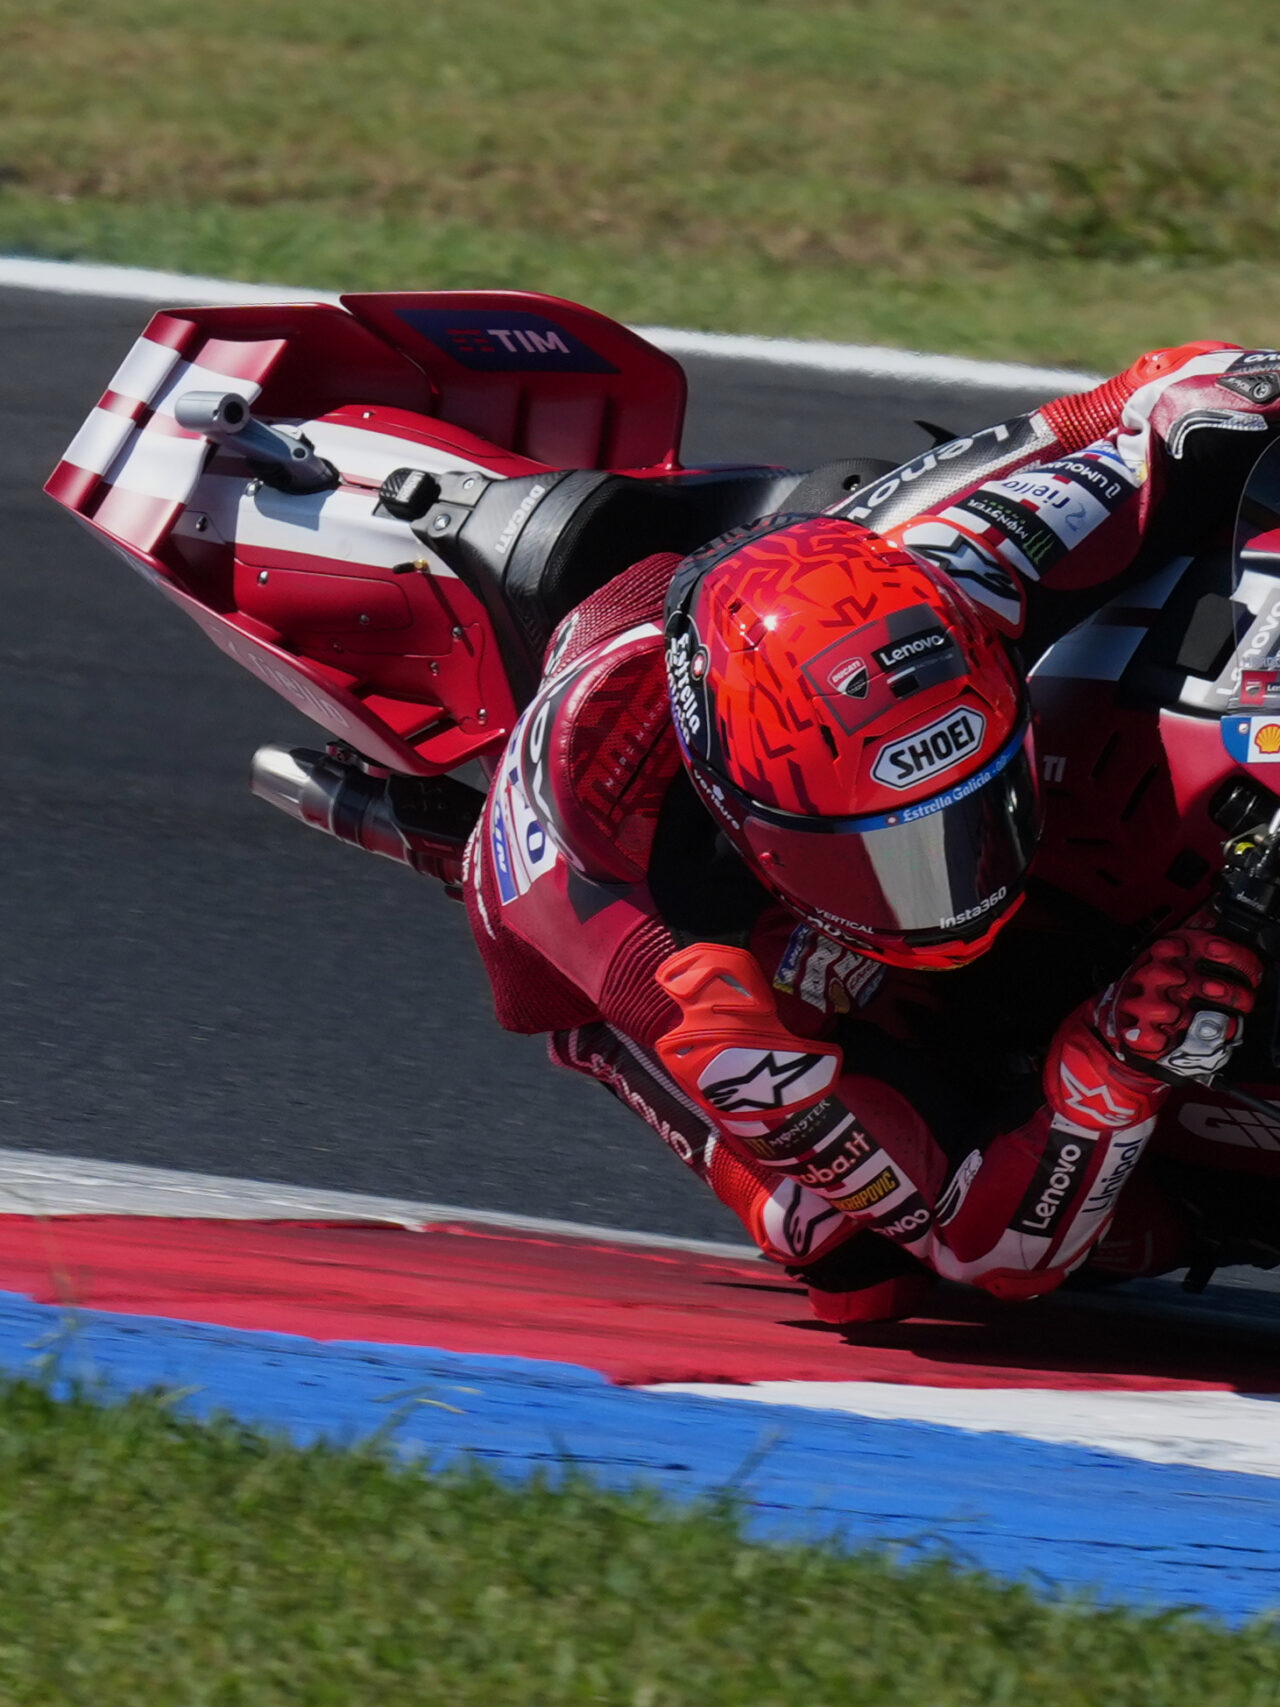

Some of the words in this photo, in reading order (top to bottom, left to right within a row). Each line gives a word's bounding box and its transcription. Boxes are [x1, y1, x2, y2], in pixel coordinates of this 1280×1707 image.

[487, 329, 571, 353] TIM
[847, 424, 1009, 521] Lenov
[495, 484, 546, 554] DUCATI
[832, 660, 861, 683] DUCATI
[880, 634, 944, 667] Lenovo
[889, 715, 975, 780] SHOEI
[693, 768, 741, 830] verisure
[903, 796, 953, 822] Estrella
[953, 771, 993, 802] Galicia
[815, 907, 874, 934] VERTICAL
[940, 886, 1007, 929] Insta360
[1022, 1143, 1081, 1229] Lenovo
[1081, 1138, 1143, 1213] Unipol
